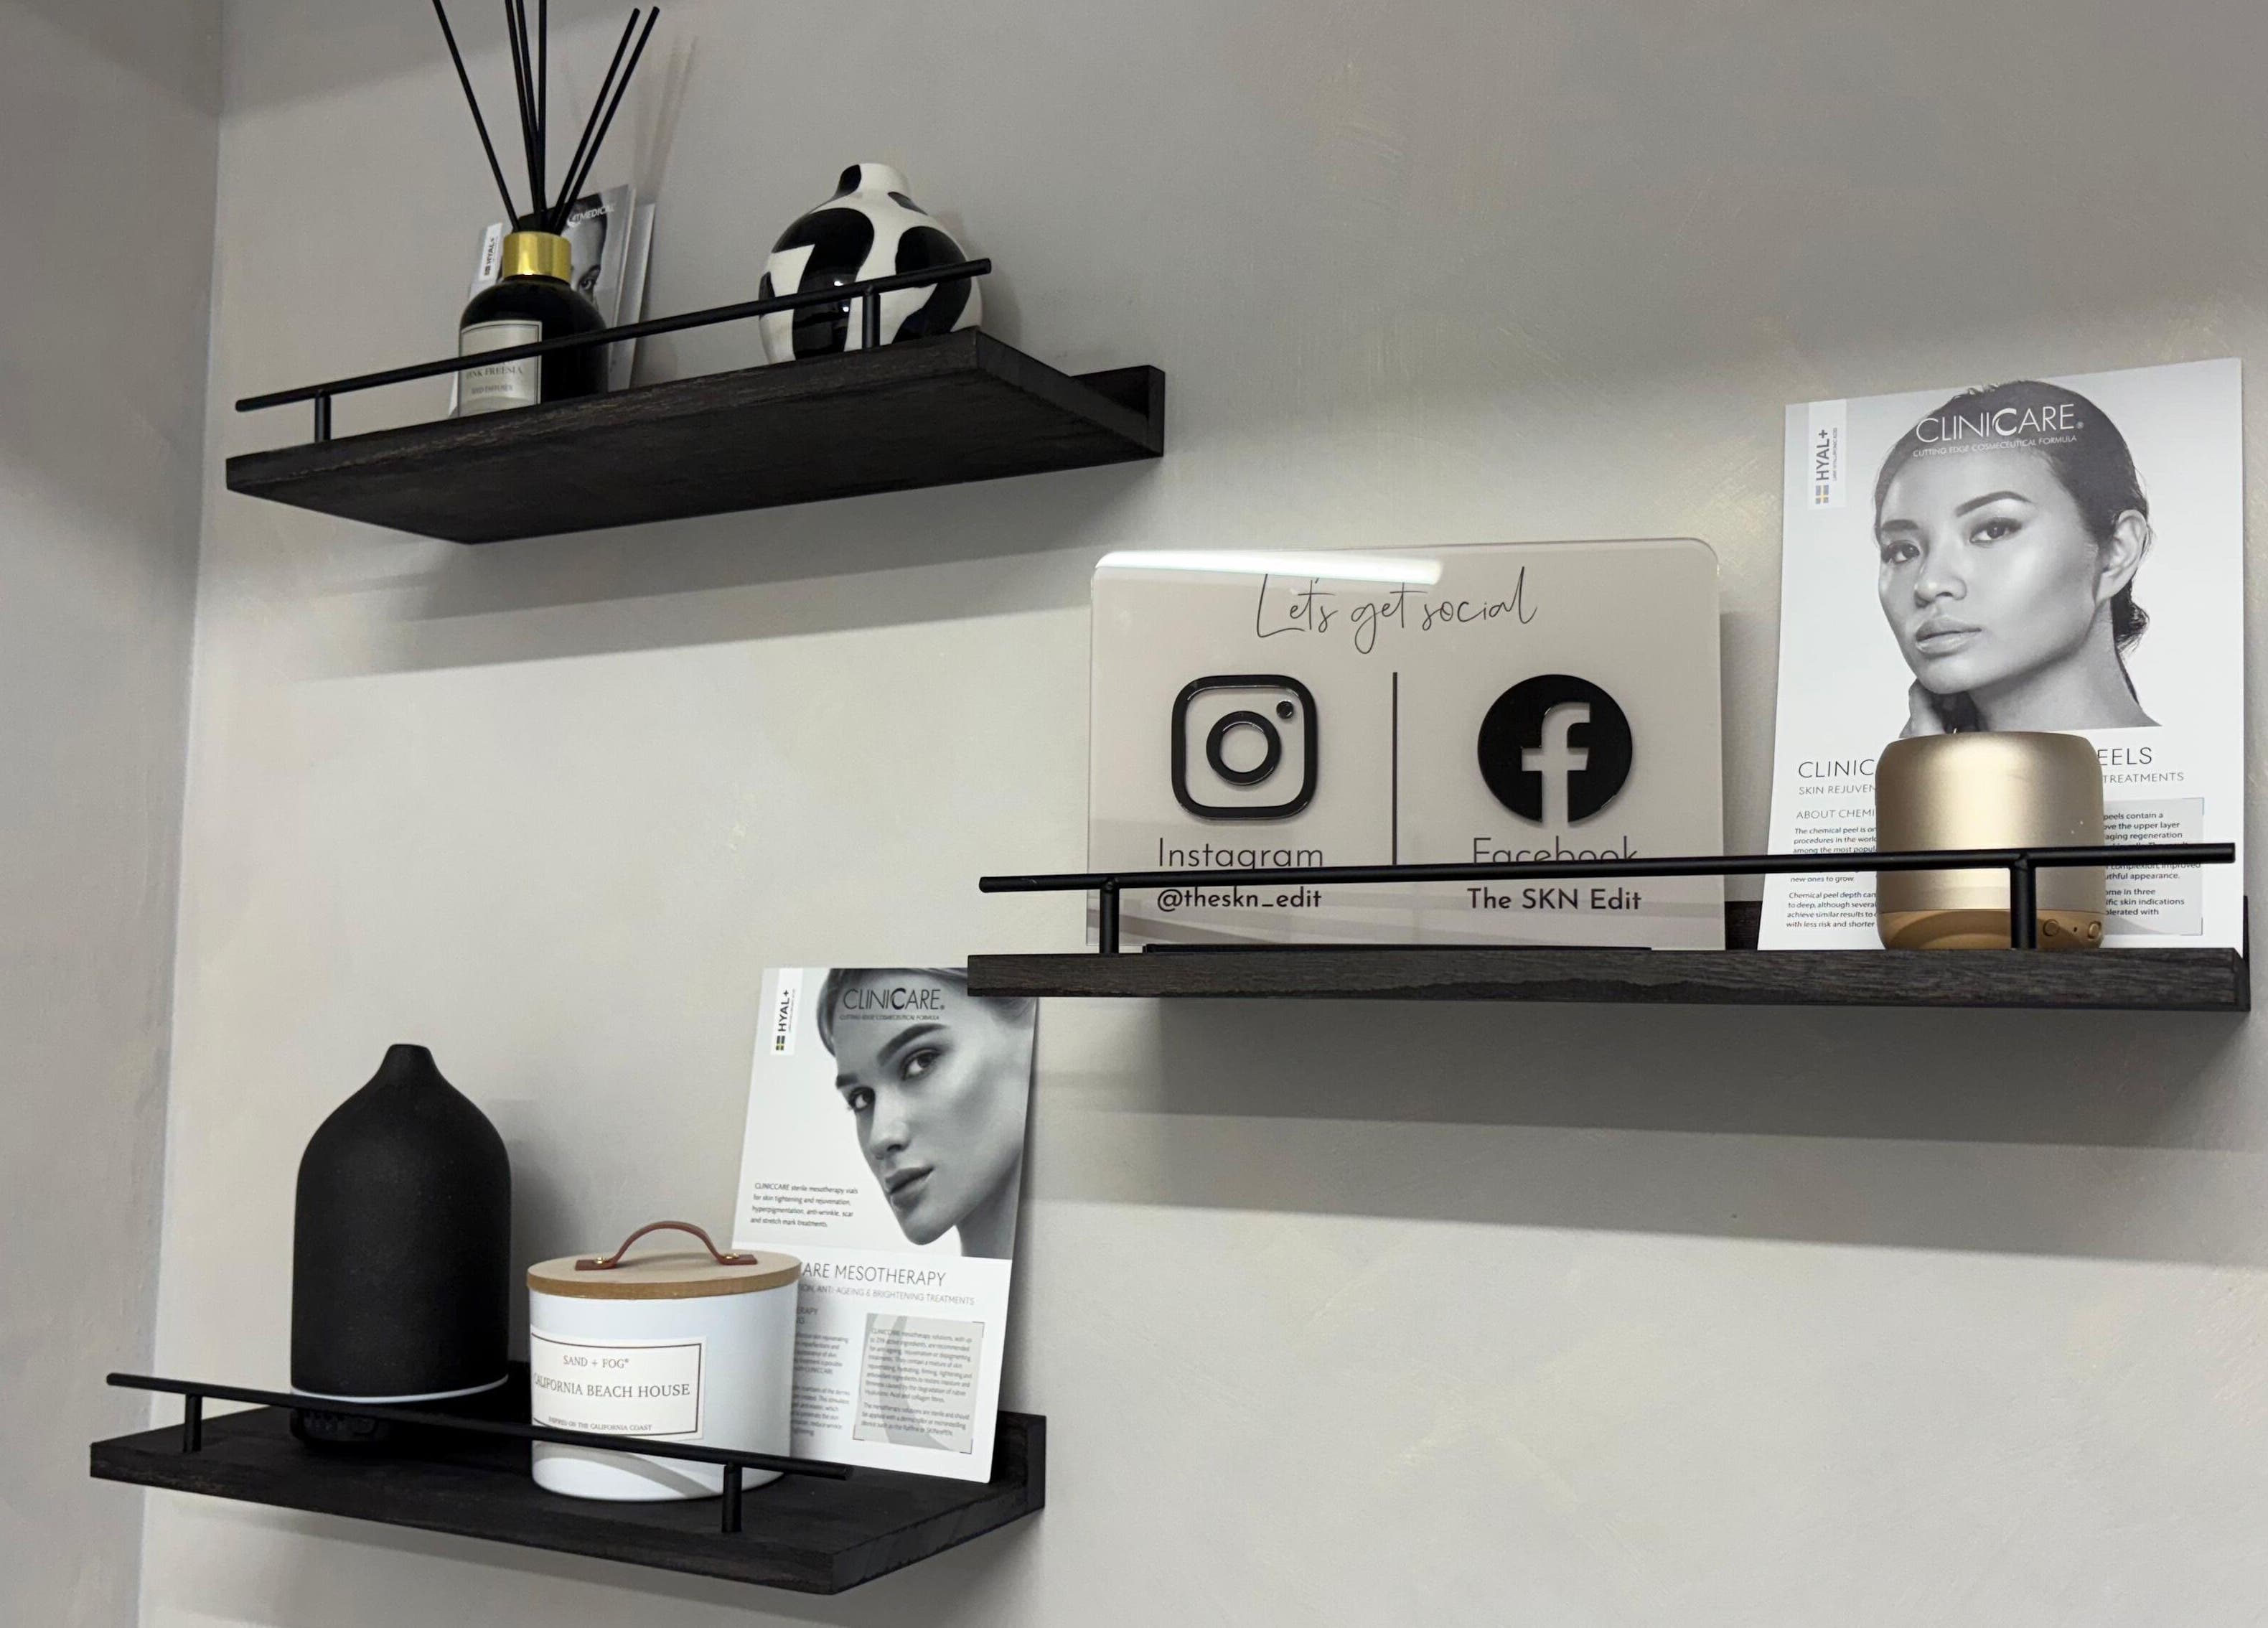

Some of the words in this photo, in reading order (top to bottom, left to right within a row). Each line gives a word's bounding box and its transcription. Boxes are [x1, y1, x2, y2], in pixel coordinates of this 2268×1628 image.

[1816, 429, 1829, 480] HYAL+
[1913, 448, 1946, 457] CUTTING
[1949, 445, 1969, 454] EDGE
[2039, 435, 2077, 444] FORMULA
[1257, 574, 1337, 637] Let's
[1351, 582, 1428, 654] get
[1423, 566, 1537, 631] social
[2103, 772, 2184, 783] TREATMENTS
[1799, 786, 1824, 795] SKIN
[1796, 810, 1836, 819] ABOUT
[1159, 838, 1323, 869] Instagram
[1158, 886, 1322, 912] @theskn_edit
[1467, 887, 1512, 909] The
[1522, 888, 1578, 909] SKN
[1591, 887, 1642, 909] Edit
[778, 990, 790, 1031] HYAL+
[835, 1264, 947, 1287] MESOTHERAPY
[873, 1289, 925, 1301] BRIGHTENING
[927, 1293, 975, 1306] TREATMENTS
[563, 1355, 588, 1367] SAND
[533, 1372, 584, 1396] CALIFORNIA
[587, 1384, 633, 1398] BEACH
[638, 1383, 690, 1398] HOUSE
